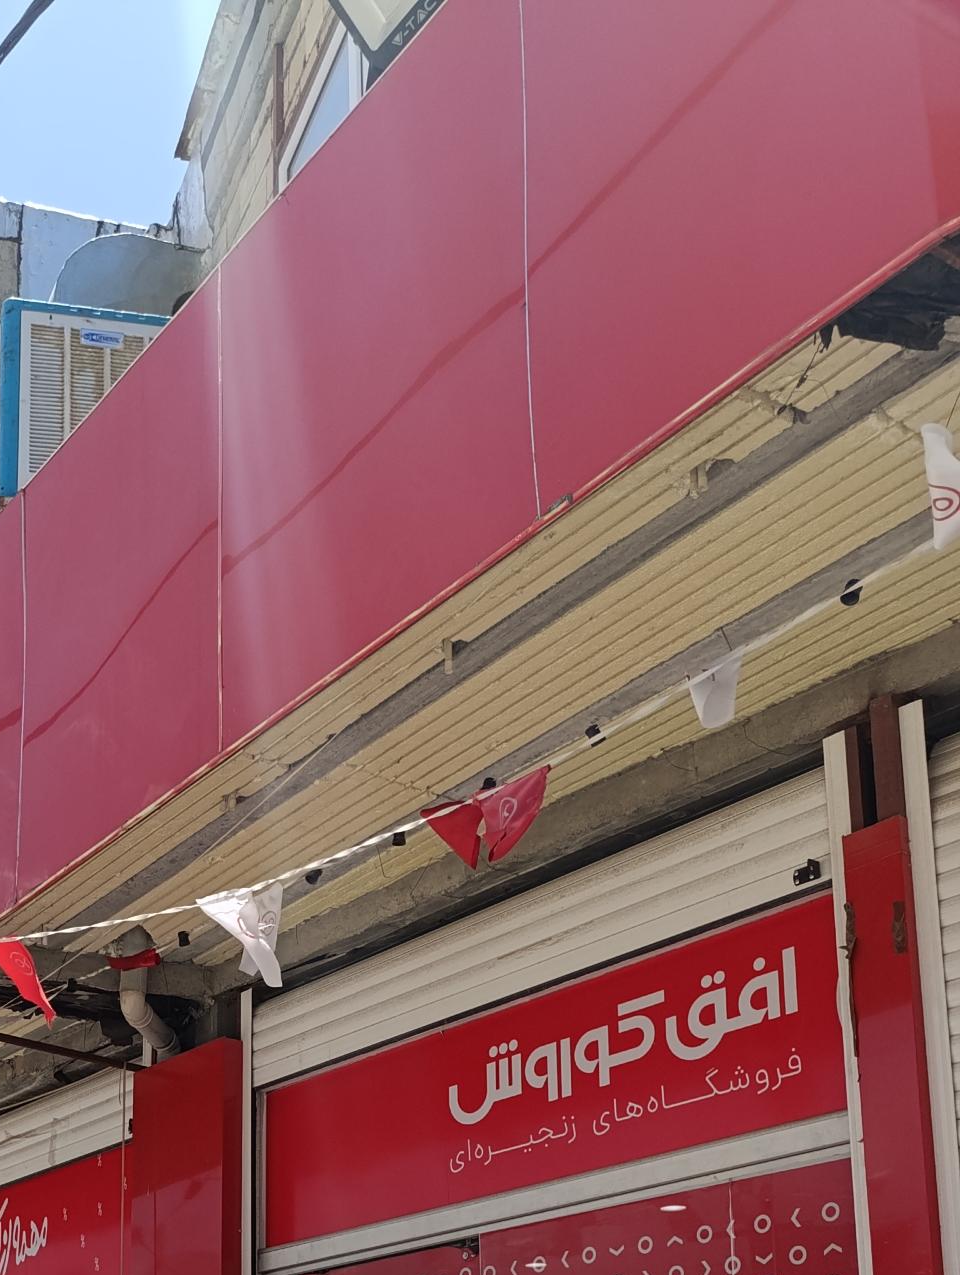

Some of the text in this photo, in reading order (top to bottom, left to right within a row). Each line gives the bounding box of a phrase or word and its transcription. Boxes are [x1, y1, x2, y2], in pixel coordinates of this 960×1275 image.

[448, 946, 799, 1126] افق کوروش
[449, 1047, 803, 1174] فروشگاه‌های زنجیره‌ای
